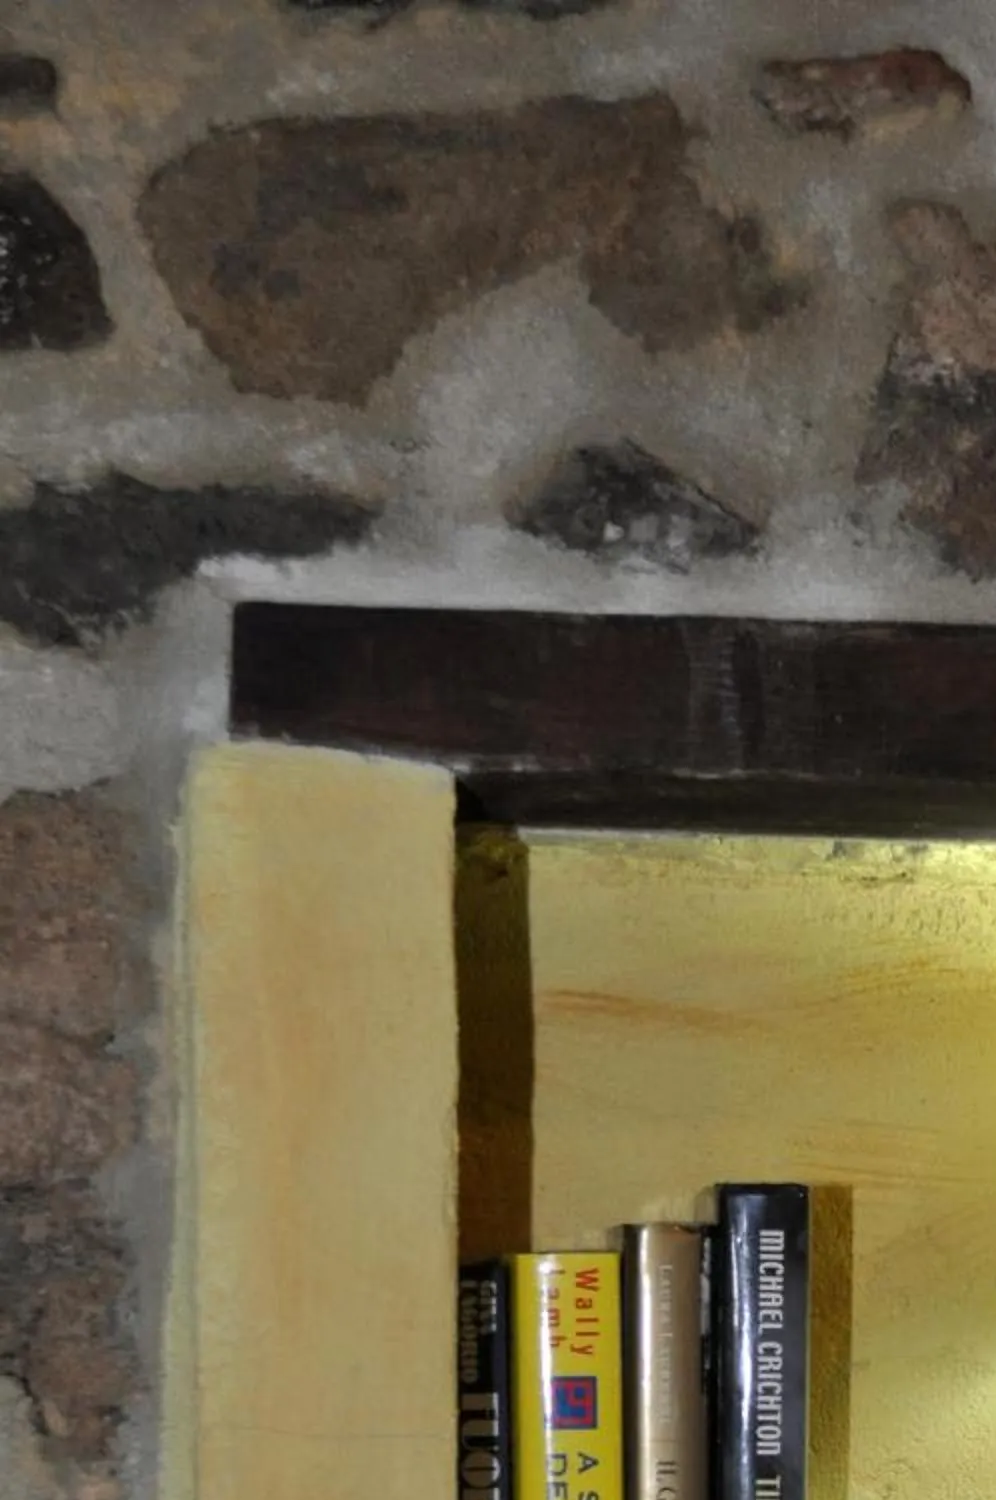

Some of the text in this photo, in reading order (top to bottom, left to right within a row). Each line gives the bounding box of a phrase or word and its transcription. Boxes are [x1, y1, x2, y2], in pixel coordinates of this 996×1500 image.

[569, 1268, 599, 1355] Wally
[756, 1228, 785, 1336] MICHAEL
[755, 1340, 783, 1456] CRICHTON
[577, 1452, 599, 1474] A
